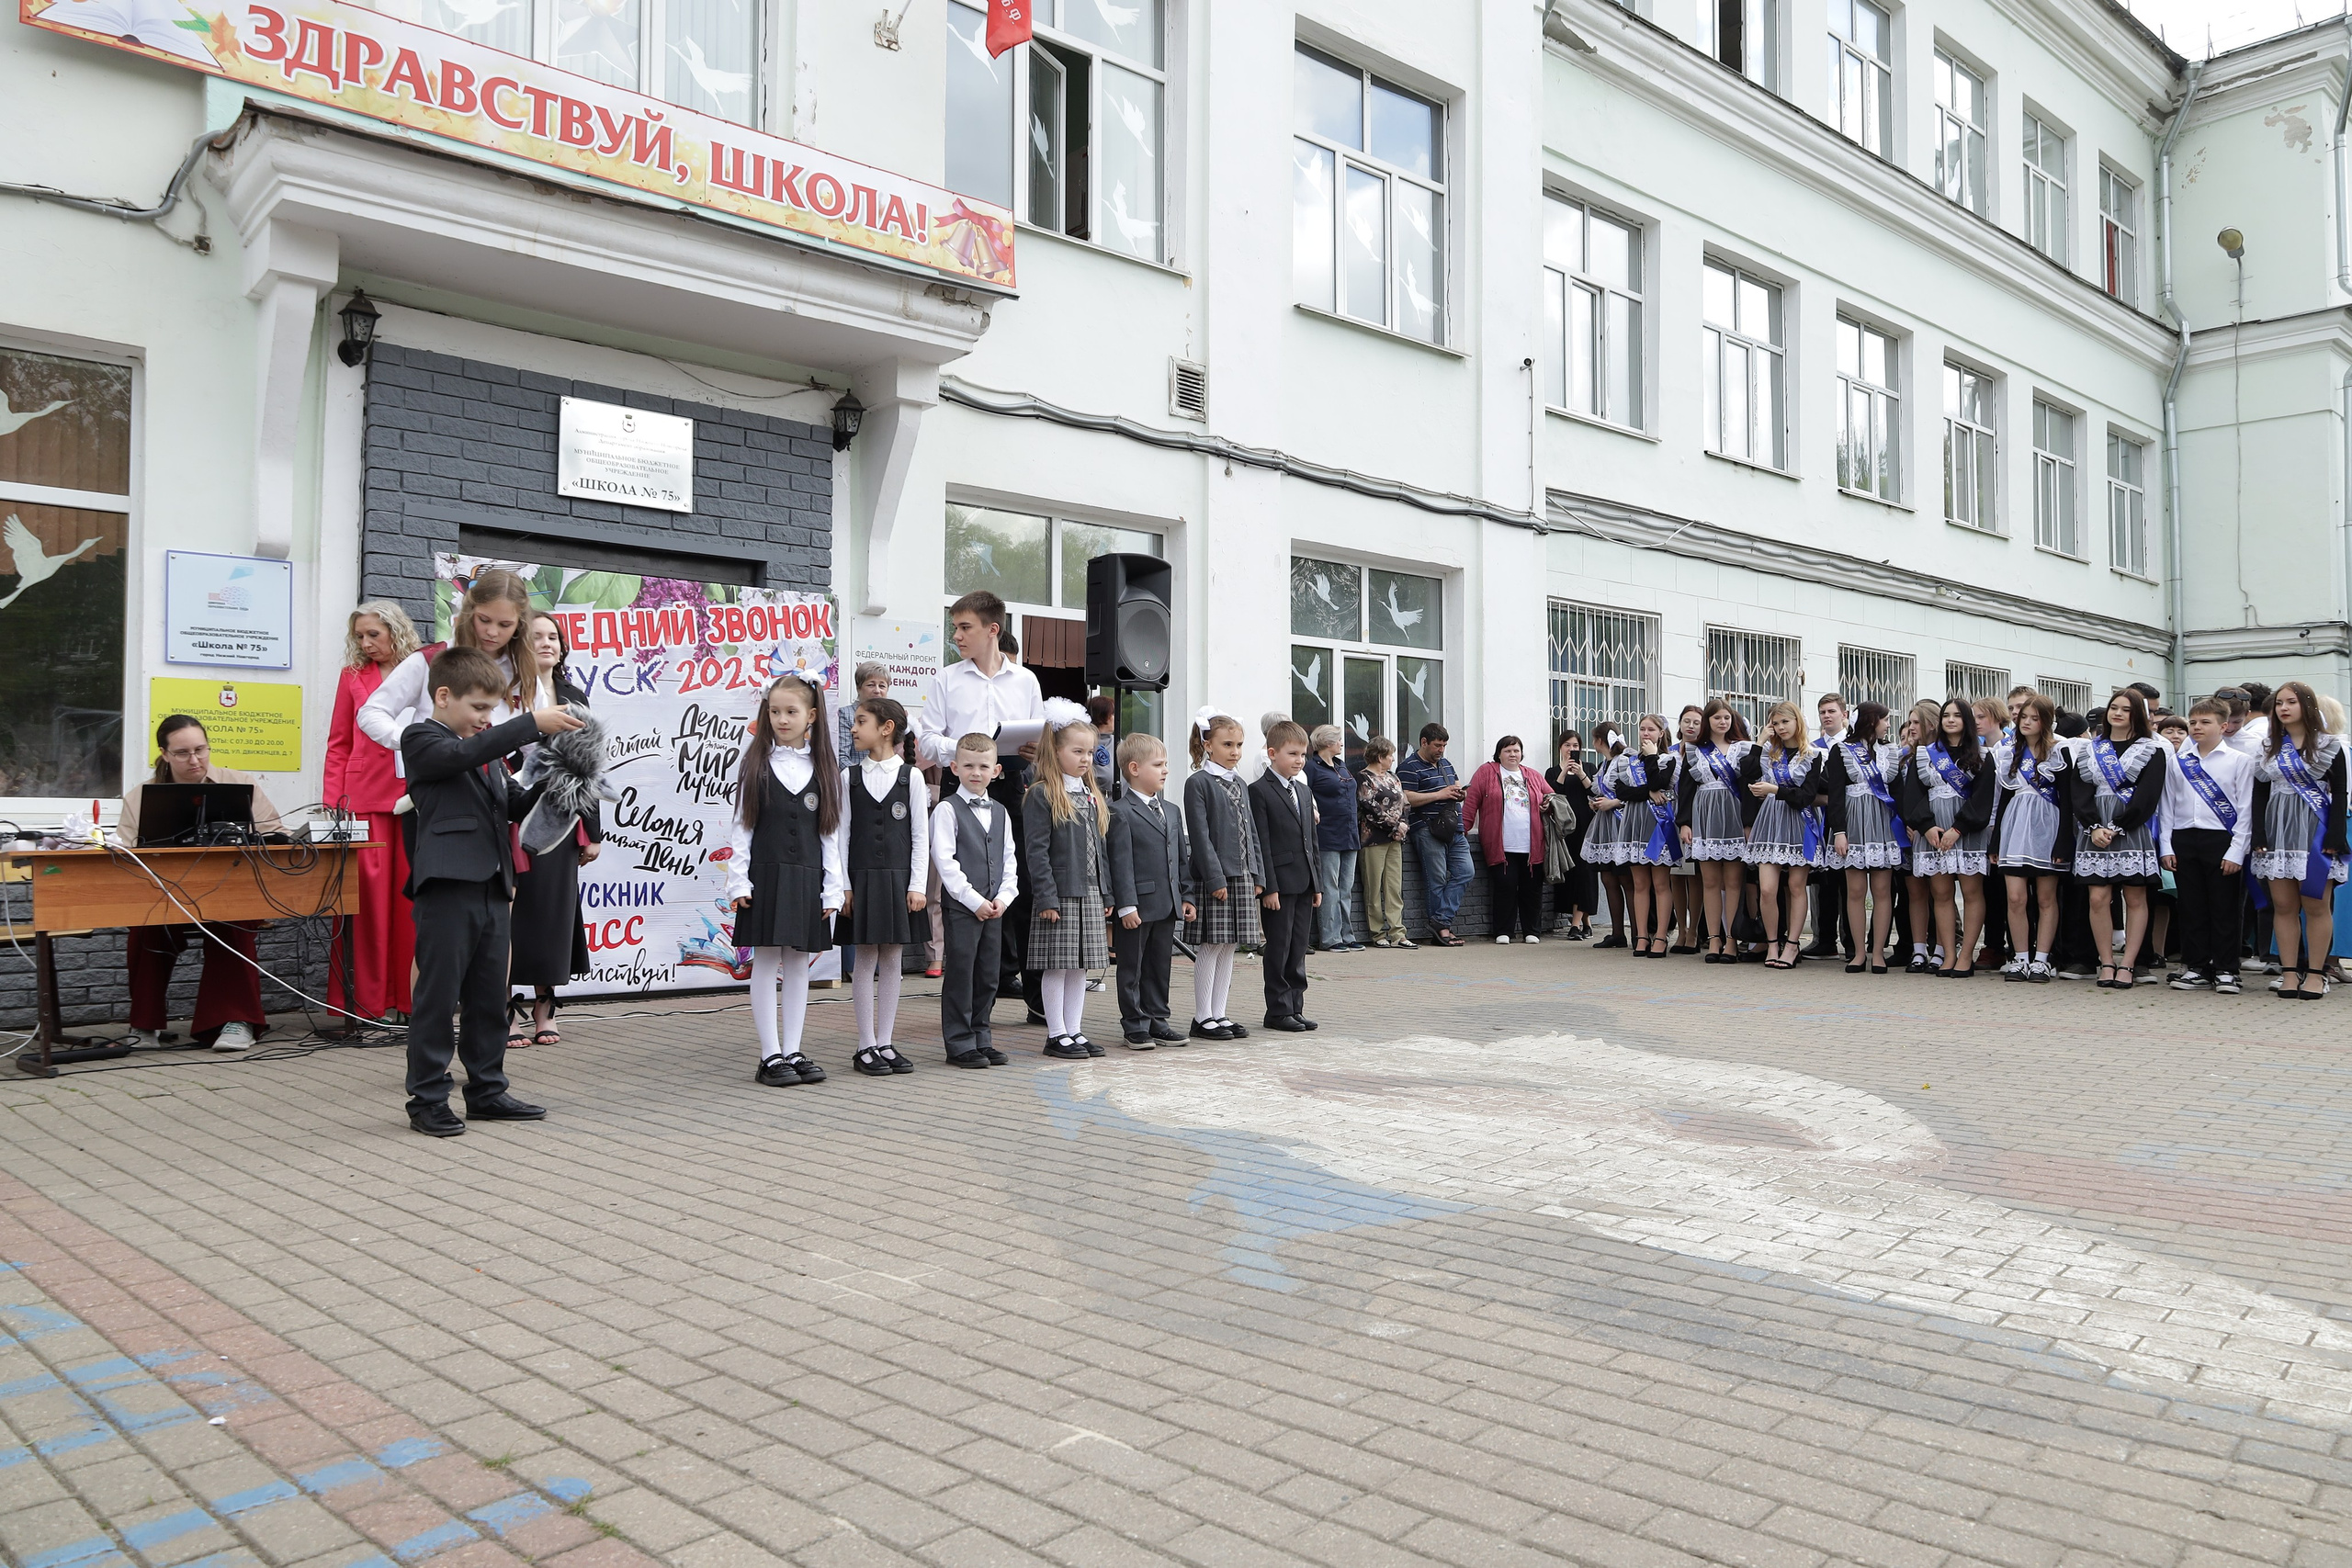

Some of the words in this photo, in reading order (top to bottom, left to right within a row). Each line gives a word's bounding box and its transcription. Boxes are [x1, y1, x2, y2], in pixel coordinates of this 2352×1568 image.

[243, 4, 689, 184] ЗДРАВСТВУЙ,
[710, 141, 929, 244] ШКОЛА!
[573, 448, 637, 462] МУНИЦИПАЛЬНОЕ
[638, 458, 681, 469] БЮДЖЕТНОЕ
[586, 457, 669, 475] ОБЩЕОБРАЗОВАТЕЛЬНОЕ
[605, 467, 651, 479] УЧРЕЖДЕНИЕ
[571, 478, 638, 496] «ШКОЛА
[641, 487, 658, 499] №
[662, 490, 681, 502] 75»
[549, 603, 696, 658] ЛЕДНИЙ
[707, 604, 833, 644] ЗВОНОК
[192, 641, 233, 649] «Школа
[855, 650, 909, 660] ФЕДЕРАЛЬНЫЙ
[910, 654, 937, 663] ПРОЕКТ
[567, 658, 663, 698] УСК
[677, 654, 773, 694] 2025
[888, 664, 937, 676] КАЖДОГО
[889, 678, 918, 687] ЕНКА
[171, 708, 237, 716] МУНИЦИПАЛЬНОЕ
[205, 725, 233, 733] КОЛА
[615, 786, 704, 846] Сегодня
[633, 841, 707, 881] День!
[578, 880, 666, 908] УСКНИК
[570, 948, 676, 993] ействуй!
